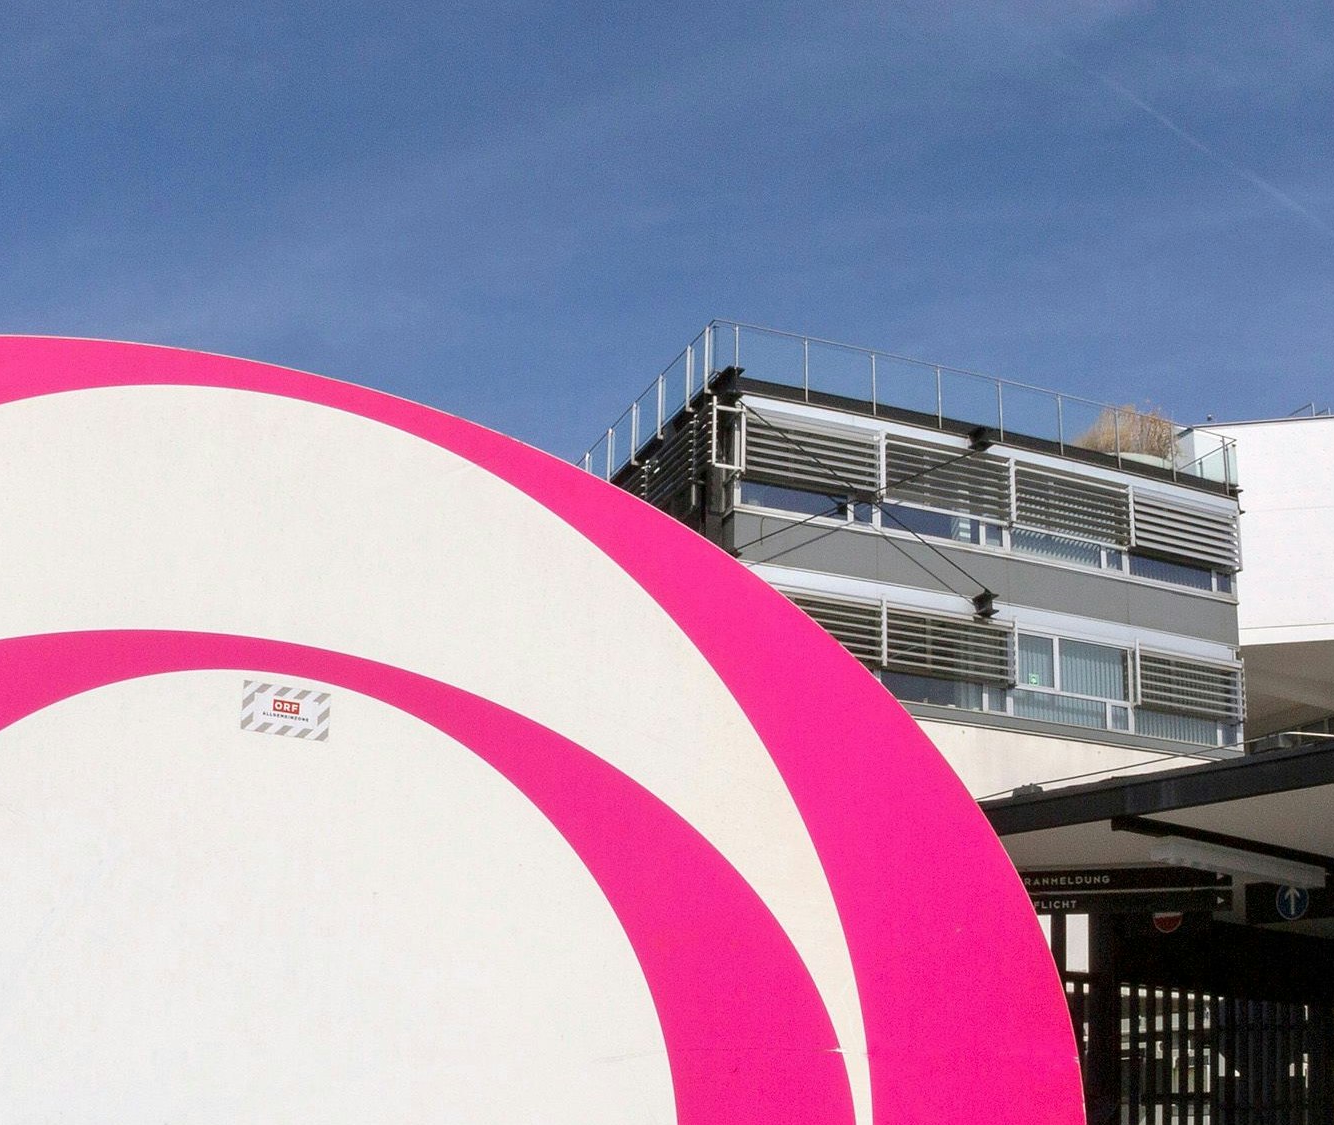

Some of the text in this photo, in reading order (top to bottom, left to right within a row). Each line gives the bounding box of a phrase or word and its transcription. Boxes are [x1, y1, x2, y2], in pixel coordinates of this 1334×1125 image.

[274, 701, 299, 712] ORF
[1024, 875, 1111, 886] RANMELDUNG
[1034, 900, 1077, 909] FLICHT
